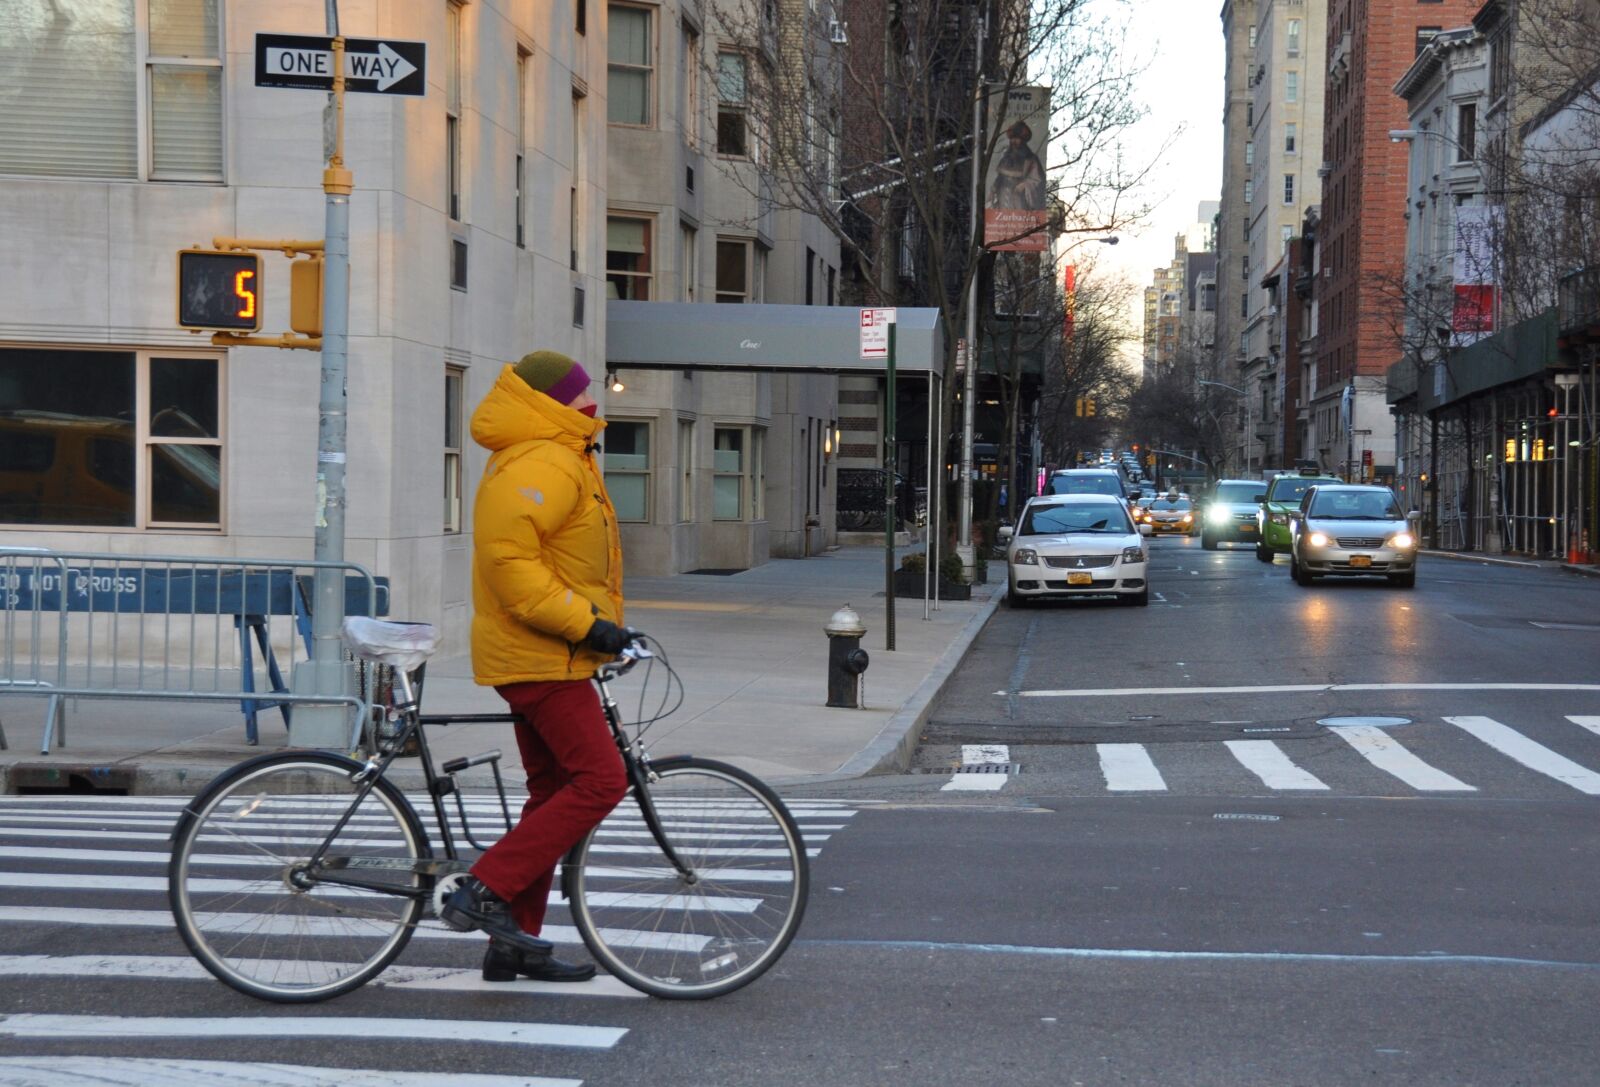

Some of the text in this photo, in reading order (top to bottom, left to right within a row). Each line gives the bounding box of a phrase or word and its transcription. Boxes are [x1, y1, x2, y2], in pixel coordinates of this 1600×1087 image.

[280, 51, 400, 77] ONE WAY
[1008, 91, 1032, 101] NYC
[235, 270, 255, 318] 5
[0, 573, 20, 591] DO
[75, 575, 137, 593] CROSS
